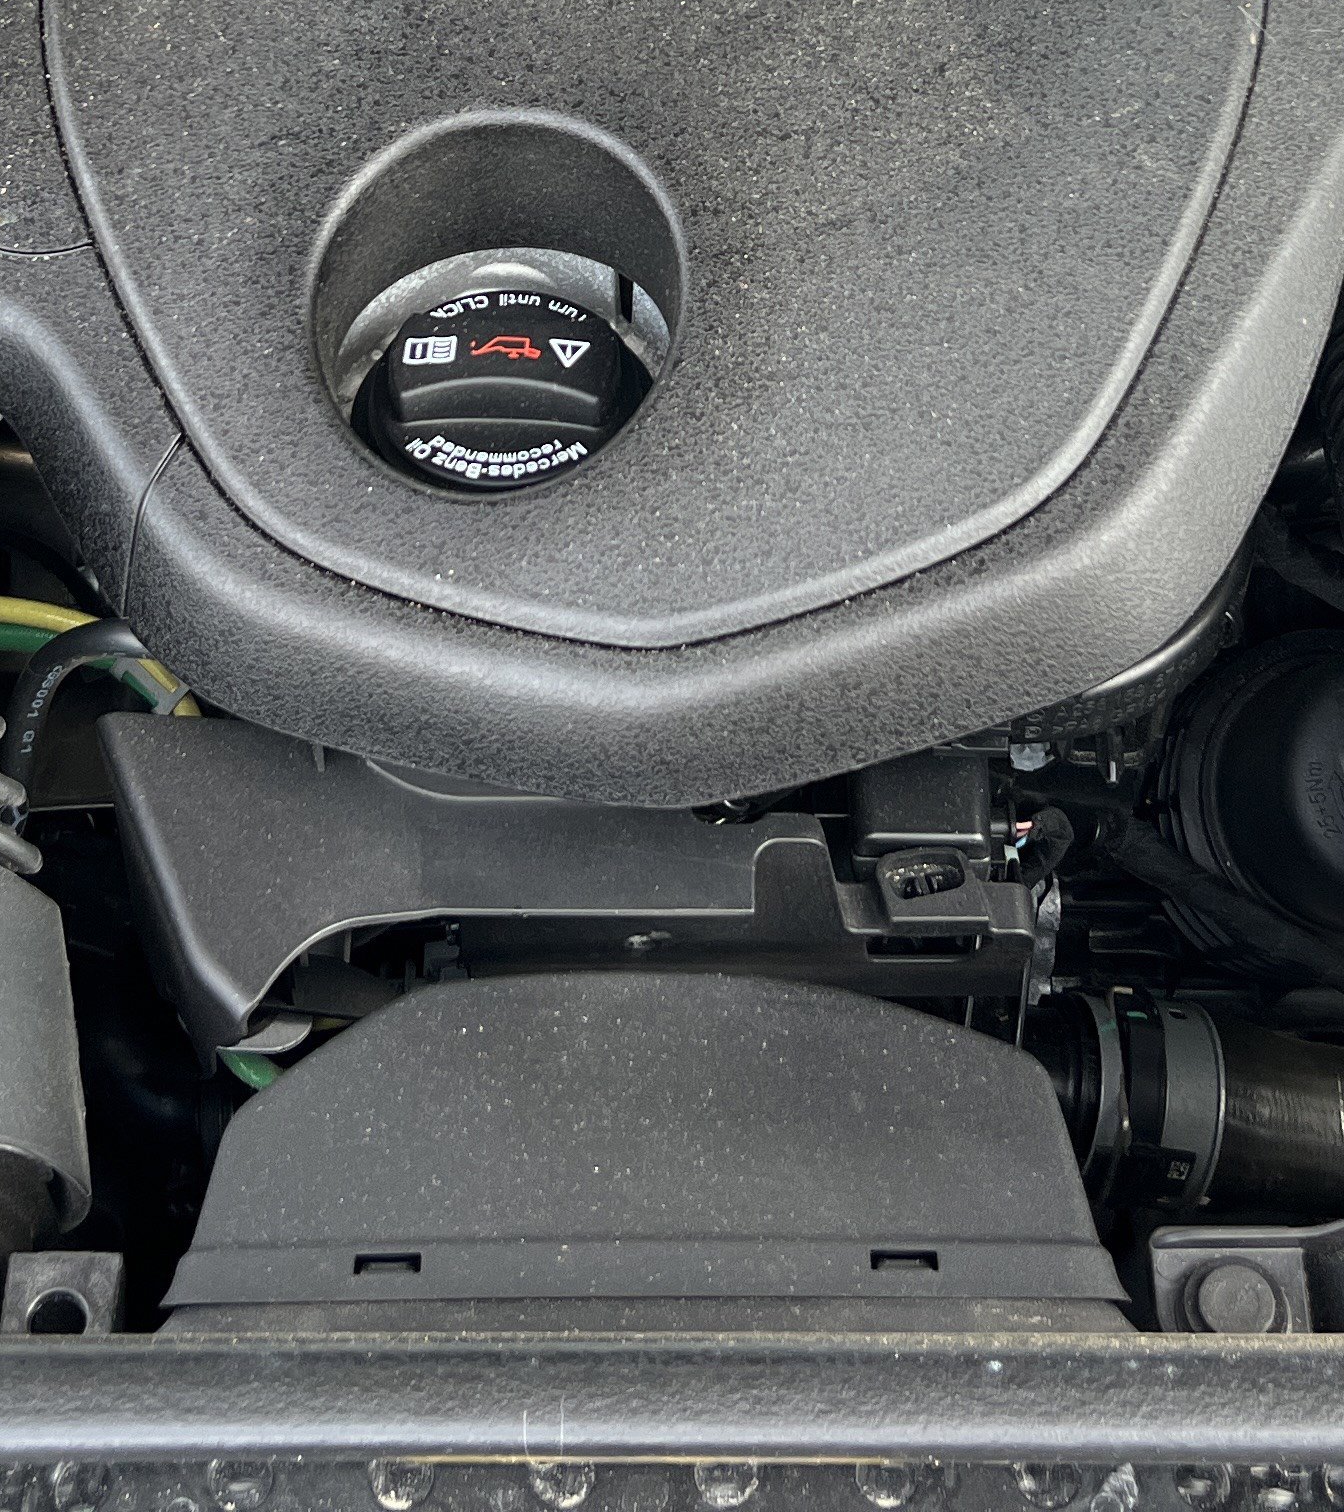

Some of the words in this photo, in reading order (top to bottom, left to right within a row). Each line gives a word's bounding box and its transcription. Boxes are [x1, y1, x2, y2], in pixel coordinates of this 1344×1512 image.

[498, 293, 541, 307] until
[405, 437, 432, 460] Oil
[427, 434, 563, 464] recommended
[430, 441, 588, 479] Mercedes-Benz
